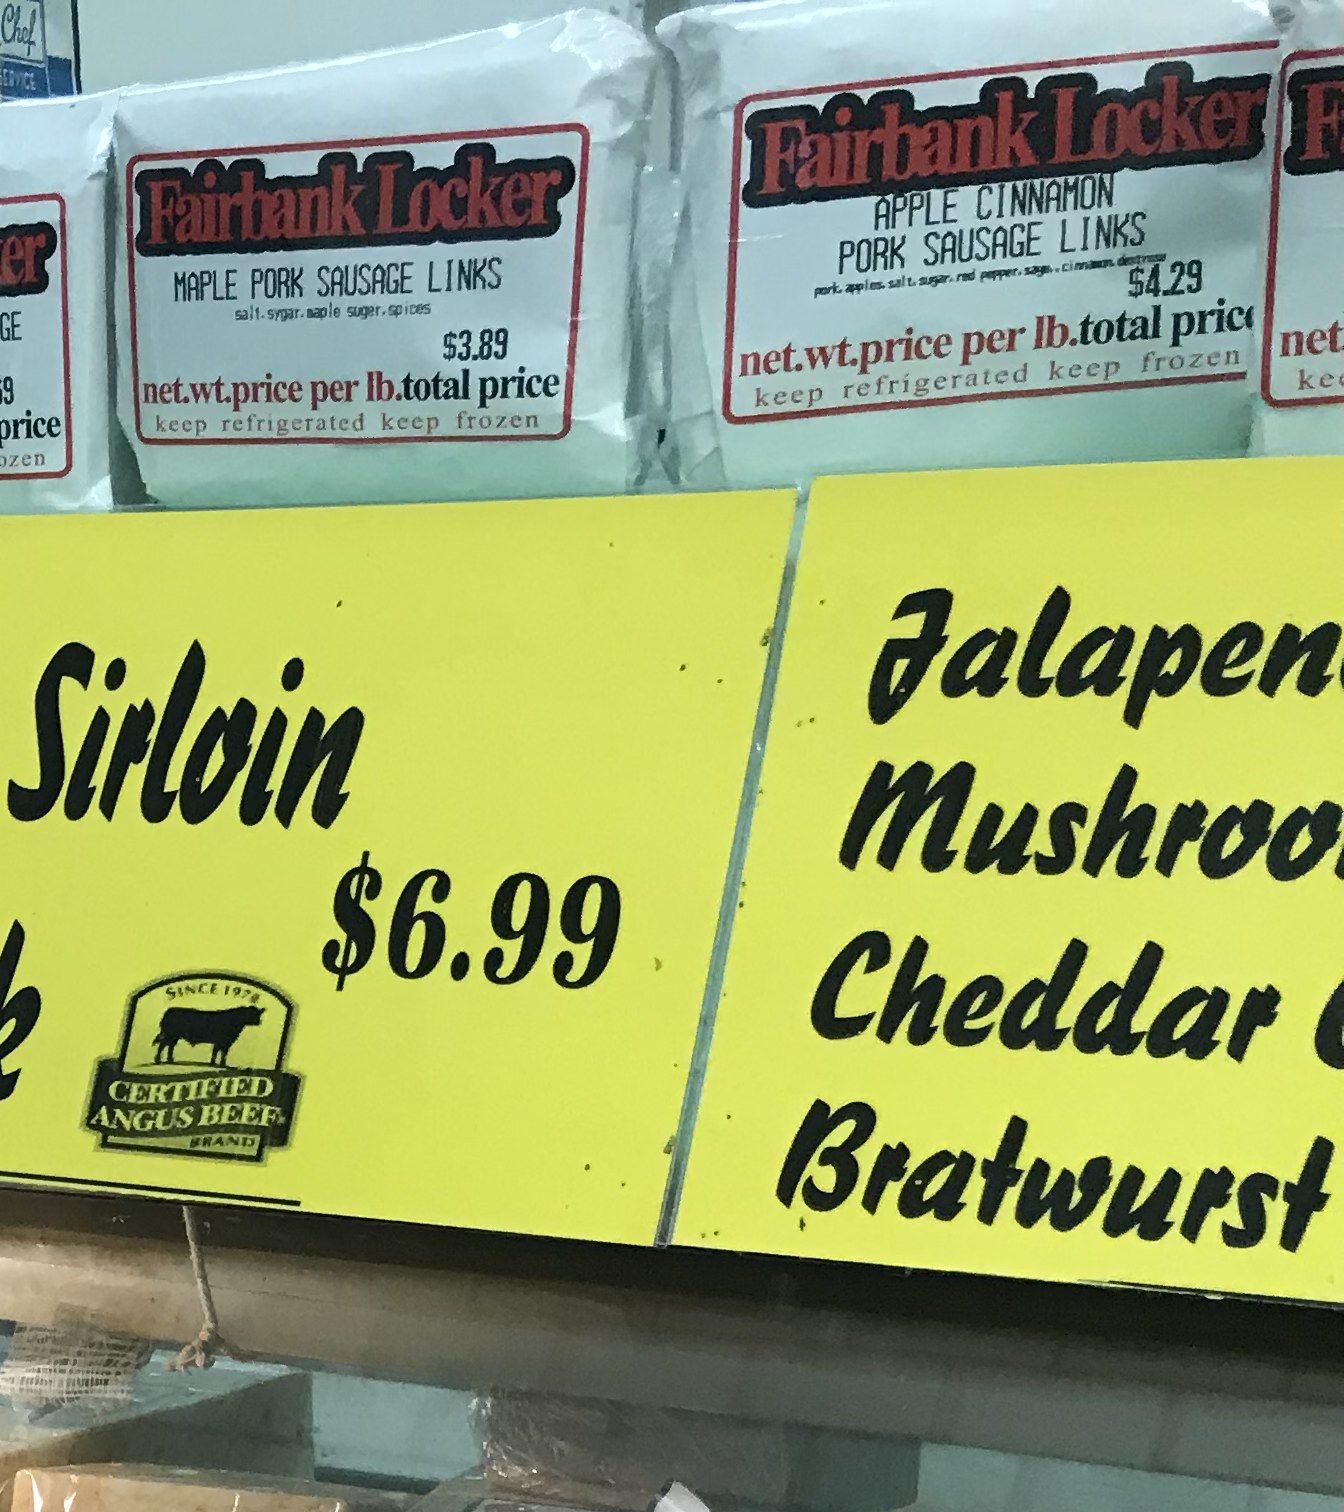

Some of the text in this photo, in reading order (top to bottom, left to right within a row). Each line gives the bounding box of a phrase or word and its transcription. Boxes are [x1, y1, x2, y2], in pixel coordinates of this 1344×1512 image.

[2, 3, 36, 56] Chef
[747, 65, 1269, 204] Fairbank Locker
[139, 144, 571, 254] Fairbank Locker
[874, 172, 1116, 232] APPLE CINNAMON
[838, 233, 906, 275] PORK
[923, 224, 1042, 266] SAUSAGE
[1059, 212, 1146, 254] LINKS
[174, 258, 503, 302] MAPLE PORK SAUSAGE LINKS
[1127, 259, 1203, 299] $4.29
[443, 328, 508, 362] $3.89
[866, 585, 1344, 729] Jalapen
[6, 638, 367, 829] Sirloin
[838, 760, 1344, 882] Mushroo
[321, 850, 622, 990] $6.99
[810, 931, 1282, 1064] Cheddar
[90, 1102, 283, 1132] ANGUS BEEF
[108, 1077, 274, 1103] CERTIFIED
[190, 1135, 255, 1149] BRAND
[774, 1097, 1335, 1252] Bratwurst
